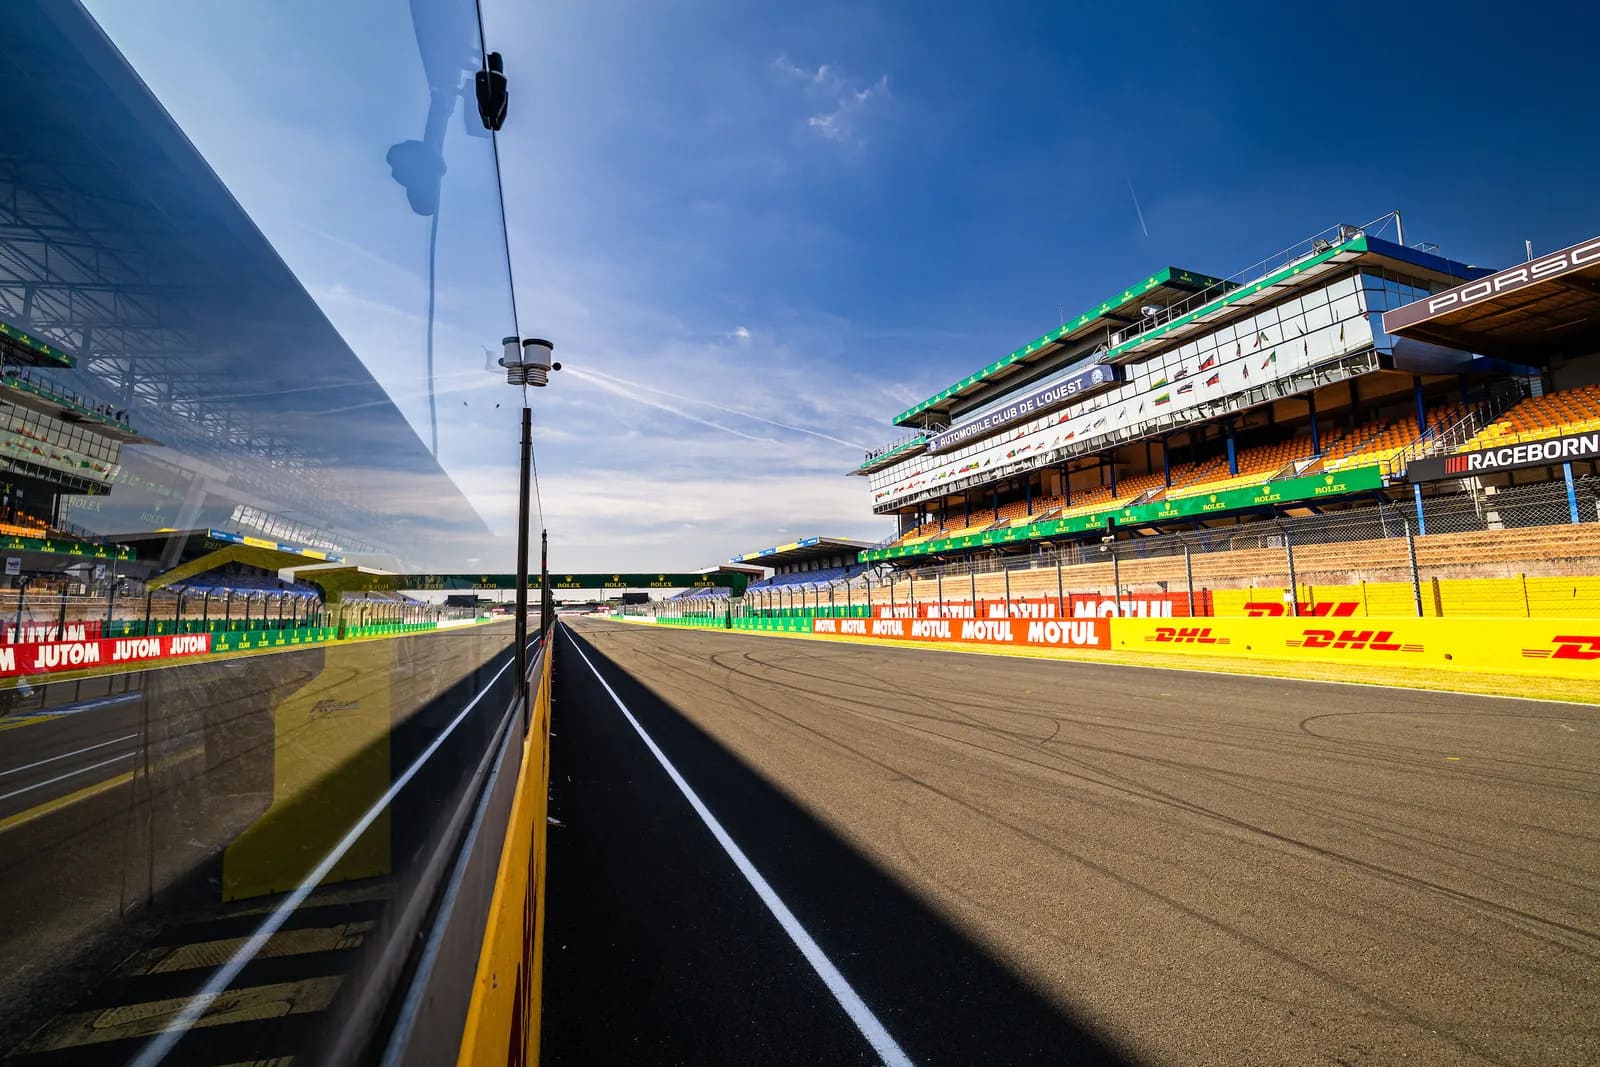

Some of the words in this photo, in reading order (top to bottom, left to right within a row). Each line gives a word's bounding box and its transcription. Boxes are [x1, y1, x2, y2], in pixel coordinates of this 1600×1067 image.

[940, 420, 991, 447] AUTOMOBILE
[992, 408, 1018, 424] CLUB
[1020, 401, 1034, 414] DE
[1036, 379, 1083, 407] L'OUEST
[1467, 434, 1599, 471] RACEBORN
[1315, 483, 1347, 494] ROLEX
[1203, 502, 1226, 511] ROLEX
[1254, 494, 1281, 503] ROLEX
[815, 619, 836, 633] MOTUL
[841, 619, 867, 634] MOTUL
[872, 619, 904, 636] MOTUL
[911, 620, 952, 638] MOTUL
[961, 620, 1014, 641] MOTUL
[1027, 621, 1099, 645] MOTUL
[1155, 627, 1218, 644] DHL
[1302, 629, 1401, 652] DHL
